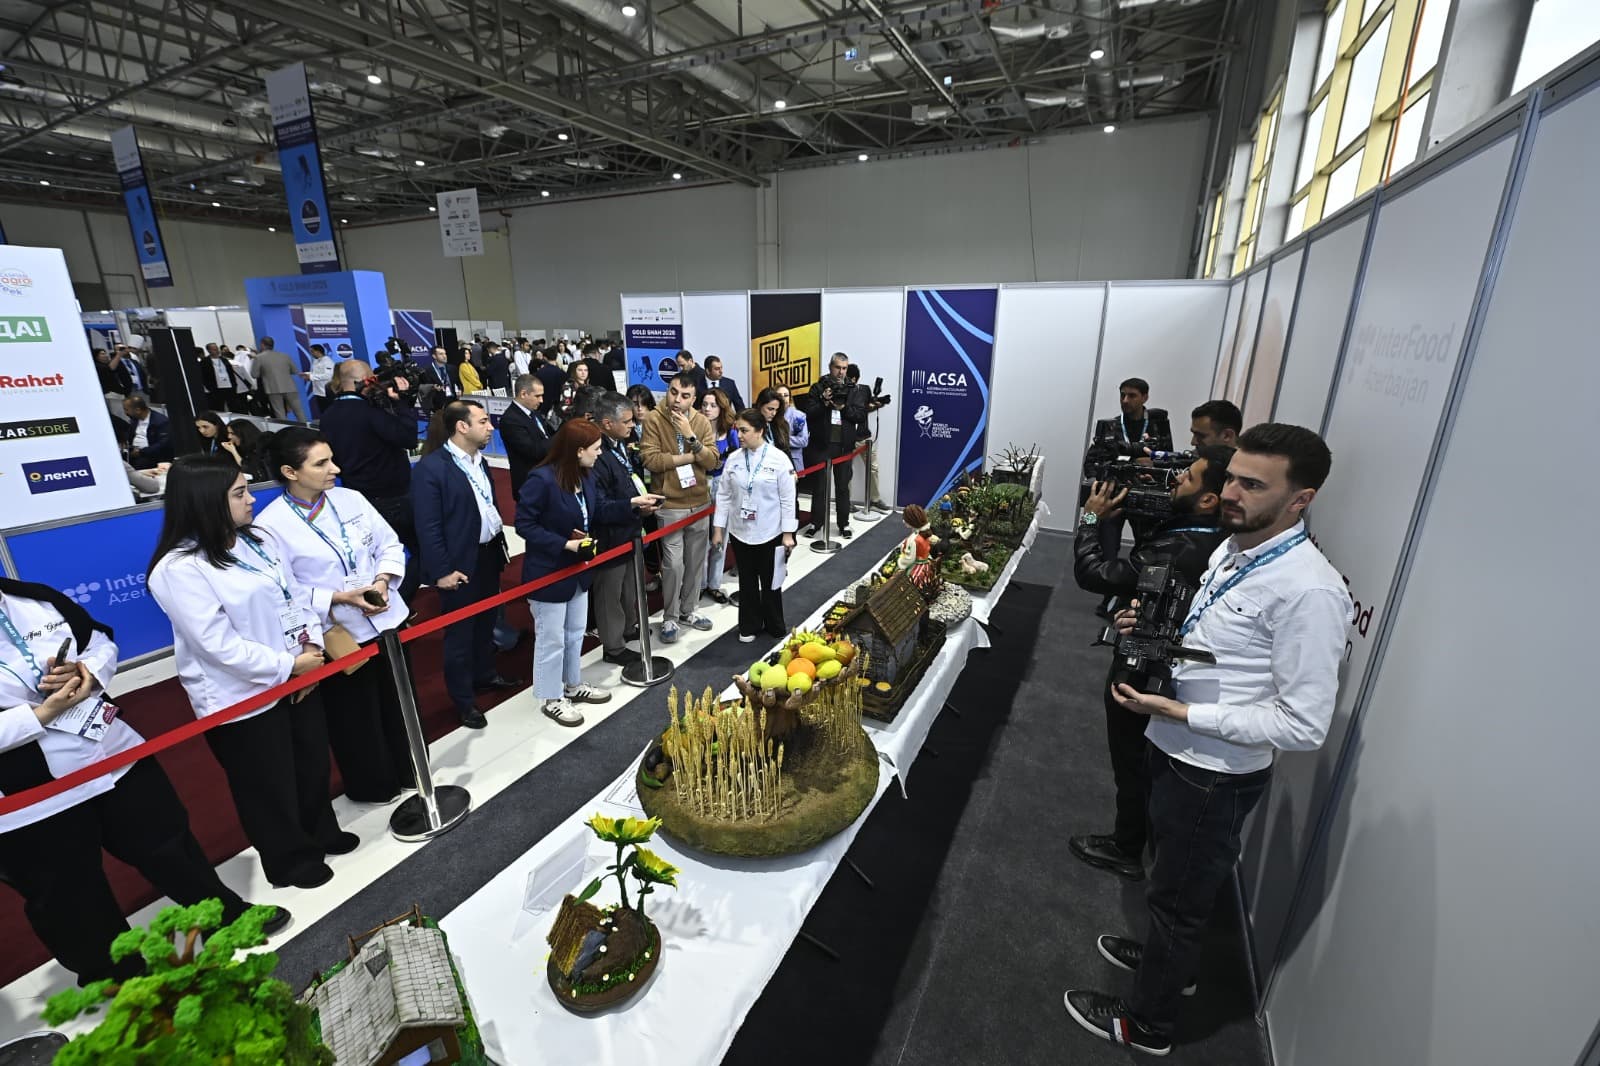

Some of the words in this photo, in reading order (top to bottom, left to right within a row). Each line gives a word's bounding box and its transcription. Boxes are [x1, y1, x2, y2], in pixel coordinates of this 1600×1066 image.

[764, 342, 785, 366] DUZ
[0, 373, 64, 388] Rahat
[927, 372, 967, 387] ACSA
[44, 469, 89, 481] лента
